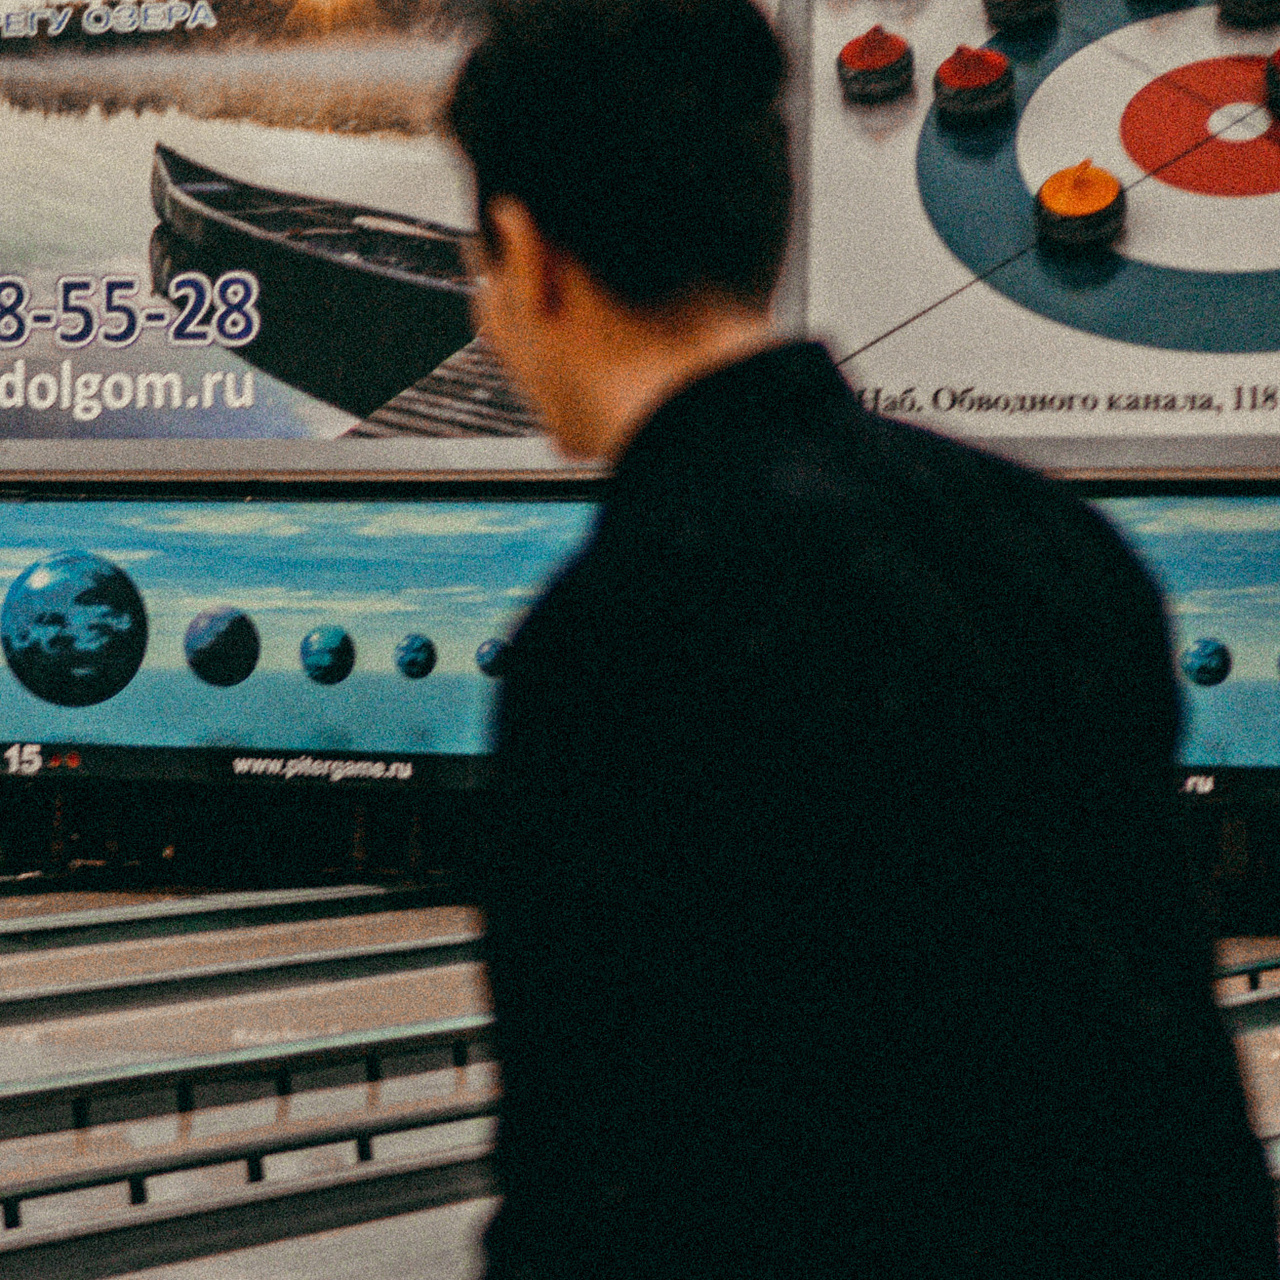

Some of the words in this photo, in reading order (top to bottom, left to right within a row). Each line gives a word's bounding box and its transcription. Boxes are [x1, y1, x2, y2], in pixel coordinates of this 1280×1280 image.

[81, 0, 220, 35] ОЗЕРА
[931, 385, 1099, 416] Обводного
[1106, 392, 1222, 415] канала,
[1232, 384, 1277, 412] 118
[3, 742, 43, 776] 15
[231, 754, 414, 782] www.pitergame.ru
